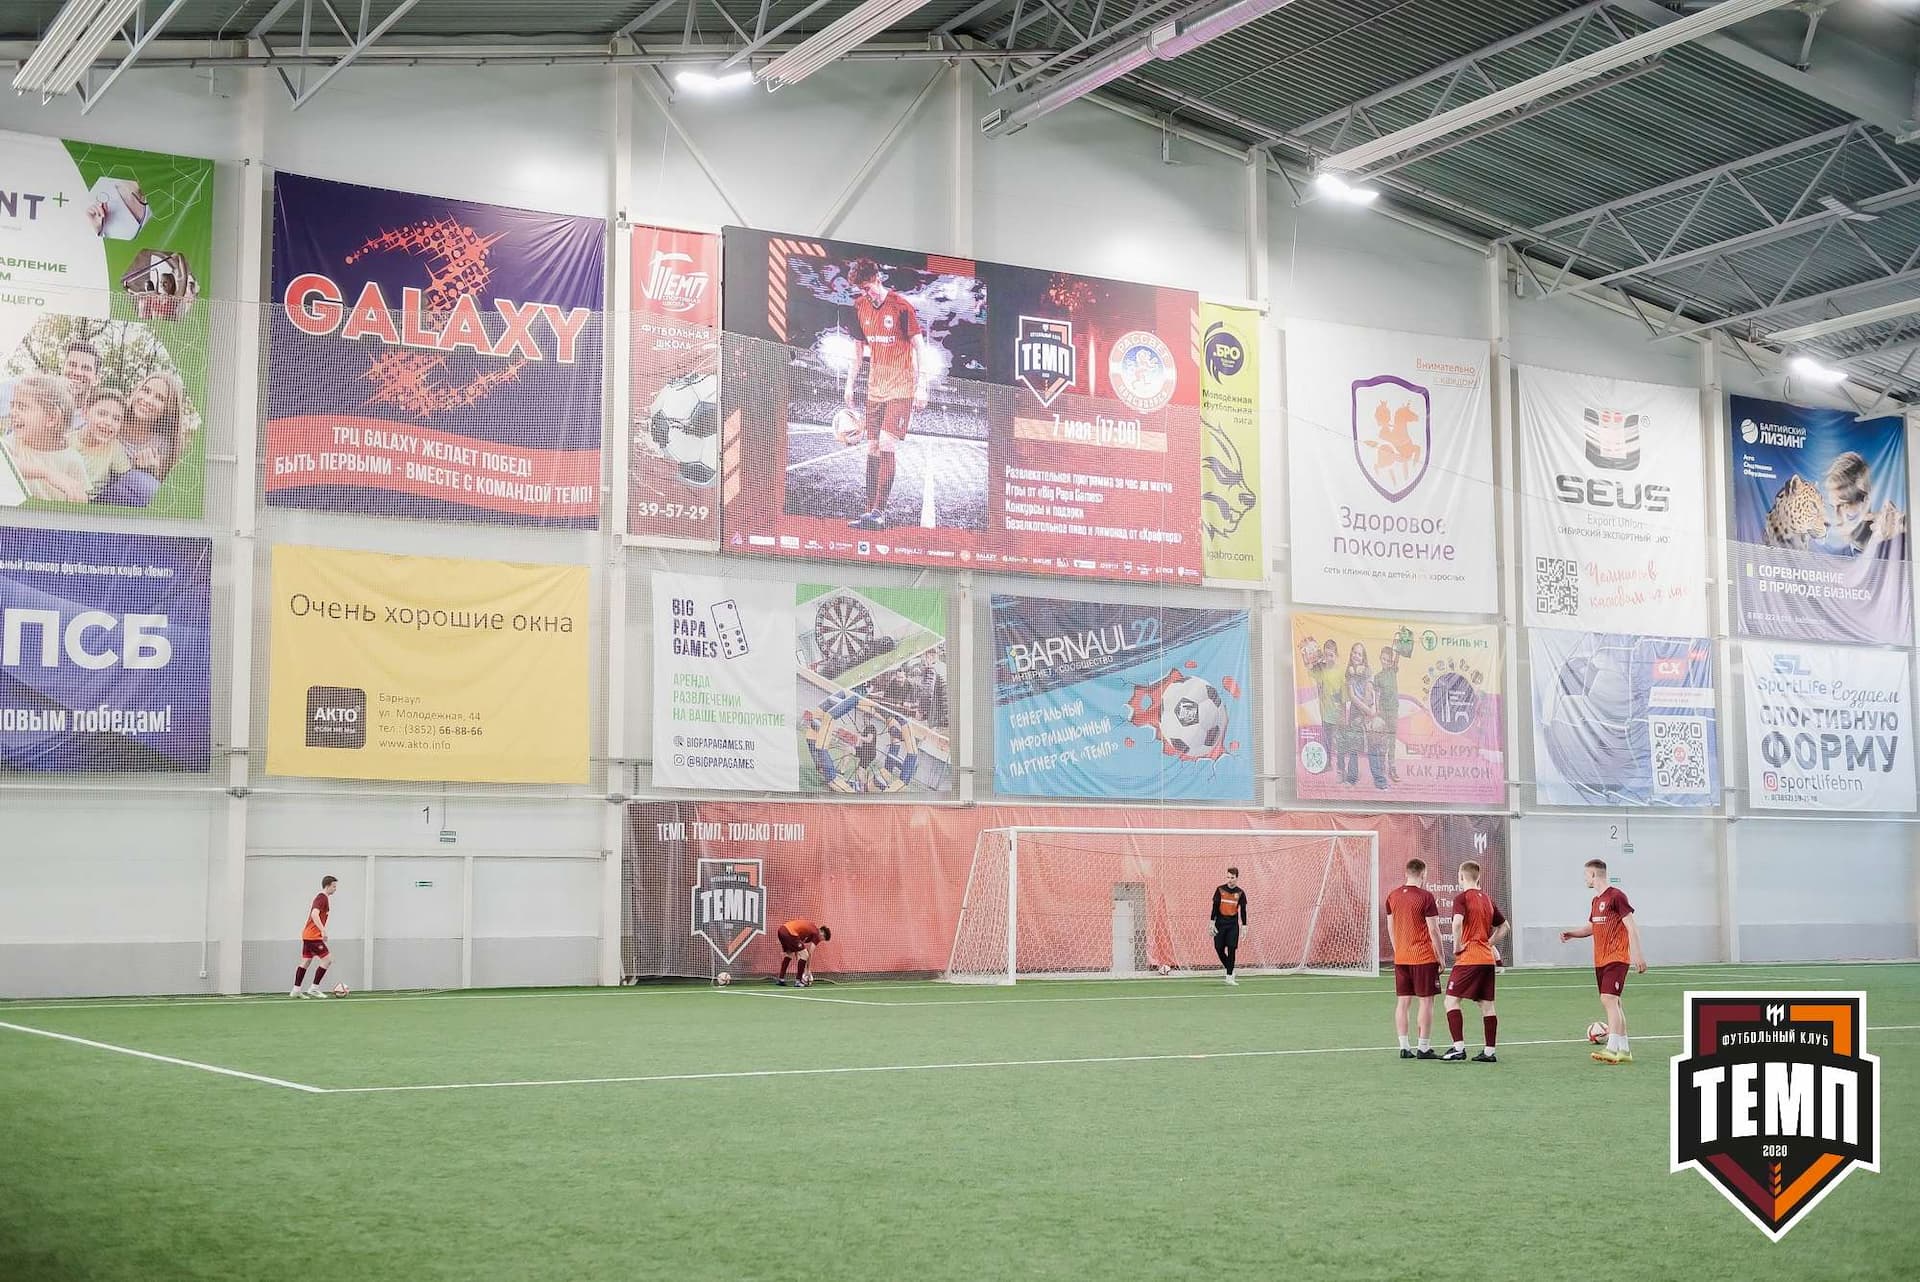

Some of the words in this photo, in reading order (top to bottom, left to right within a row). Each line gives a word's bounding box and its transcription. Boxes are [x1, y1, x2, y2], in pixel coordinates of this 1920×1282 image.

[284, 273, 590, 363] GALAXY
[641, 324, 710, 339] ФУТБОЛЬНАЯ
[656, 339, 692, 350] ШКОЛА
[1021, 343, 1069, 376] ТЕМП
[1416, 358, 1475, 374] Внимательно
[1052, 414, 1060, 437] 7
[1064, 420, 1091, 440] мая
[1760, 422, 1807, 436] БАЛТИЙСКИЙ
[1760, 431, 1807, 449] ЛИЗИНГ
[332, 426, 359, 448] ТРЦ
[364, 428, 420, 455] GALAXY
[422, 438, 478, 466] ЖЕЛАЕТ
[482, 451, 533, 477] ПОБЕД!
[275, 453, 316, 475] БЫТЬ
[319, 451, 392, 476] ПЕРВЫМИ
[406, 461, 460, 487] ВМЕСТЕ
[464, 471, 473, 491] С
[476, 474, 552, 504] КОМАНДОЙ
[555, 484, 593, 504] ТЕМП!
[1555, 474, 1671, 512] SEUS
[638, 502, 710, 521] 39-57-29
[1339, 506, 1447, 534] Здоровое
[1587, 513, 1615, 527] Export
[1558, 526, 1601, 539] СИБИРСКИЙ
[1602, 530, 1651, 543] ЭКСПОРТНЫЙ
[1333, 536, 1455, 561] поколение
[1759, 565, 1845, 584] СОРЕВНОВАНИЕ
[1759, 580, 1767, 592] В
[1769, 581, 1821, 599] ПРИРОДЕ
[1823, 587, 1872, 601] БИЗНЕСА
[290, 593, 376, 623] Очень
[384, 606, 504, 631] хорошие
[512, 613, 573, 633] окна
[672, 598, 694, 617] BIG
[673, 618, 706, 638] PAPA
[3, 608, 172, 669] ПСБ
[673, 638, 718, 658] GAMES
[1441, 637, 1471, 647] ГРИЛЬ
[673, 673, 710, 688] АРЕНДА
[1757, 677, 1827, 696] SportLife
[0, 709, 66, 731] овым
[73, 705, 171, 735] победам!
[314, 707, 357, 723] АКТО
[469, 712, 481, 721] 44
[673, 710, 687, 721] НА
[690, 711, 718, 724] ВАШЕ
[719, 712, 785, 727] МЕРОПРИЯТИЕ
[1010, 699, 1084, 728] ГЕНЕРАЛЬНЫЙ
[1759, 705, 1899, 731] СПОРТИВНУЮ
[404, 724, 436, 735] (3852)
[439, 726, 483, 736] 66-88-66
[1009, 719, 1112, 754] ИНФОРМАЦИОННЫЙ
[379, 741, 451, 750] www.akto.info
[686, 737, 755, 751] BIGPAPAGAMES.RU
[1761, 731, 1899, 773] ФОРМУ
[686, 756, 755, 770] @BIGPAPAGAMES
[1009, 753, 1059, 777] ПАРТНЕР
[1061, 751, 1078, 764] ФК
[1079, 741, 1119, 763] «ТЕМП»
[1407, 764, 1433, 777] КАК
[1780, 774, 1863, 793] sportlifebrn
[423, 806, 429, 824] 1
[656, 822, 688, 842] ТЕМП,
[691, 822, 725, 842] ТЕМП,
[727, 823, 770, 841] ТОЛЬКО
[772, 823, 804, 841] ТЕМП!
[1610, 825, 1618, 839] 2
[701, 889, 759, 923] ТЕМП
